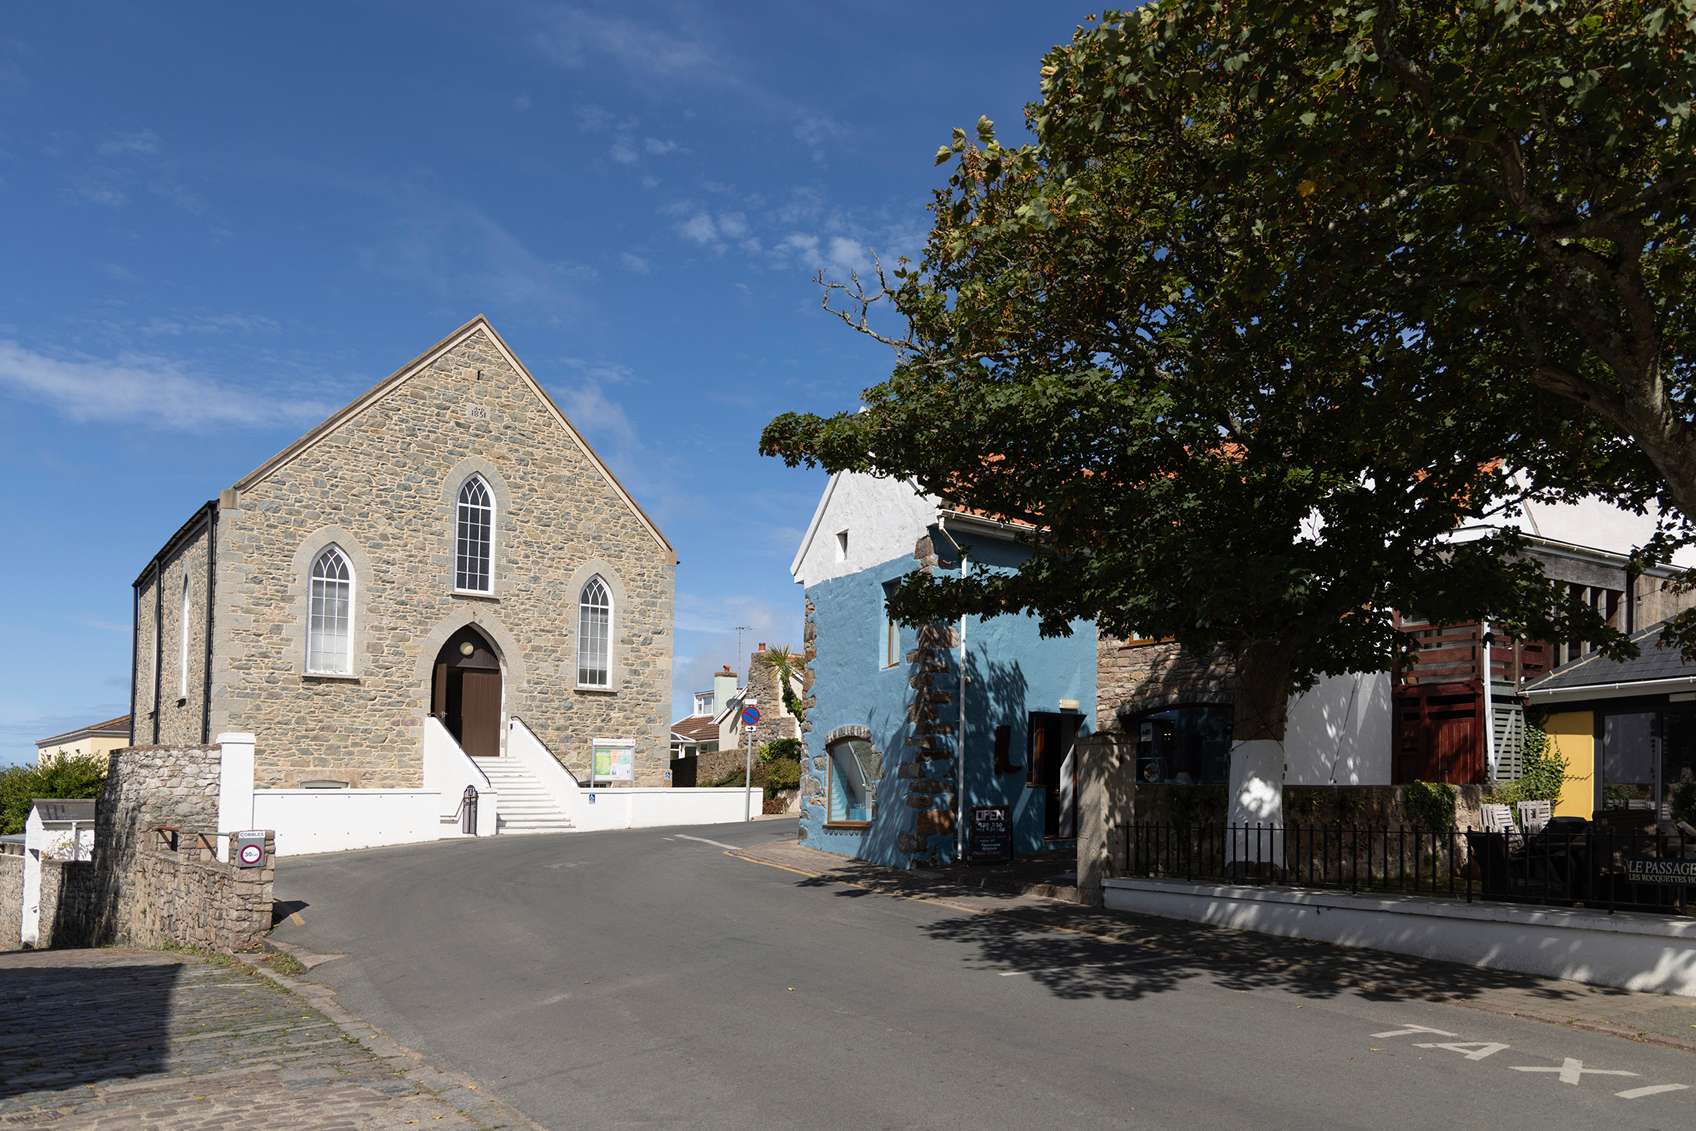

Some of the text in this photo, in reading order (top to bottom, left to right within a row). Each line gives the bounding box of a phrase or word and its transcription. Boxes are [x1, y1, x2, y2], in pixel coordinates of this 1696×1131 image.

[976, 809, 1004, 821] OPEN
[1629, 860, 1696, 874] LE PASSAGE
[1369, 1023, 1690, 1100] TAXI
